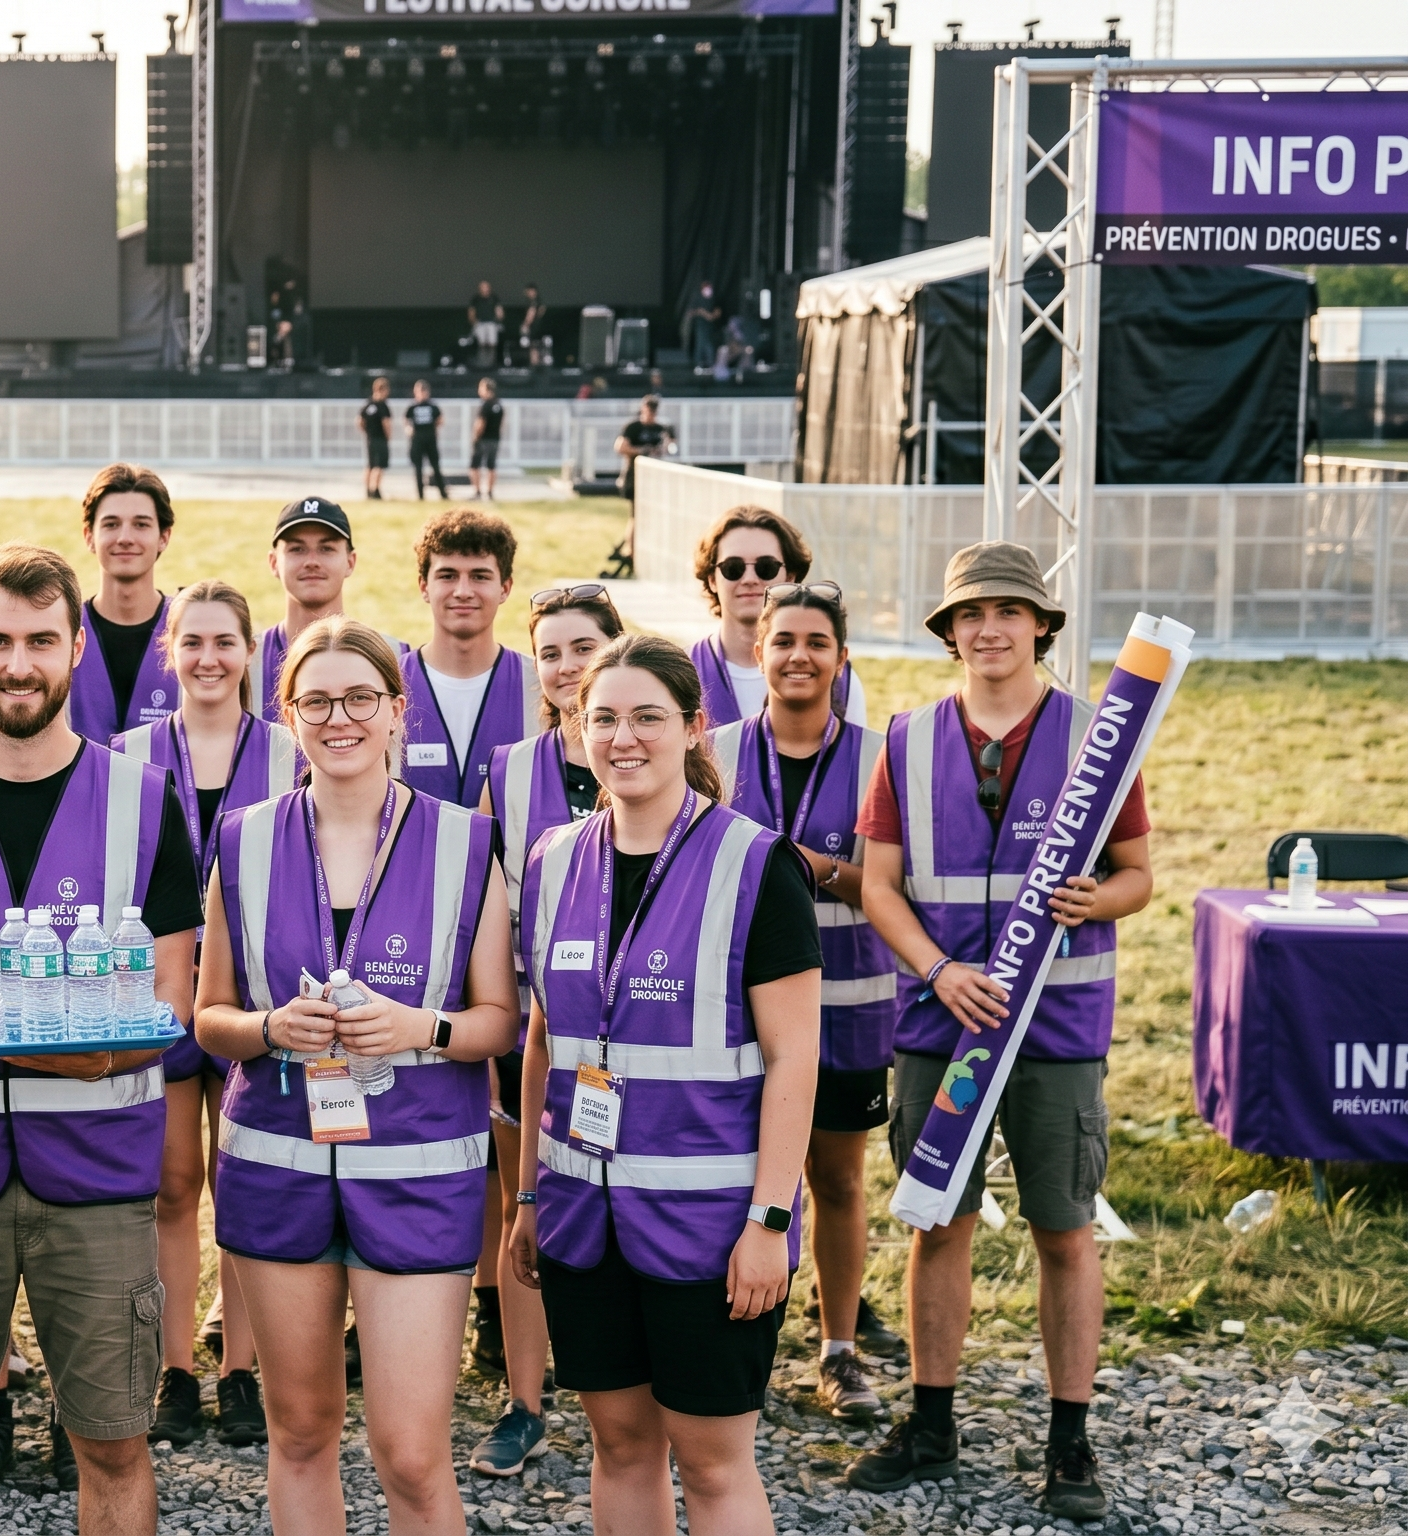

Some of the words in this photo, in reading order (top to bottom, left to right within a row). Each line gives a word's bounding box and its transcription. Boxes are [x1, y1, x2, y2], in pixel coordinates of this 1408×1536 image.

[1212, 135, 1356, 196] INFO
[1105, 220, 1257, 251] PRÉVENTION
[1265, 226, 1381, 251] DROGUES
[988, 920, 1036, 1000] NFO
[1018, 693, 1134, 916] PRÉVENTION
[368, 974, 416, 986] DROGUES
